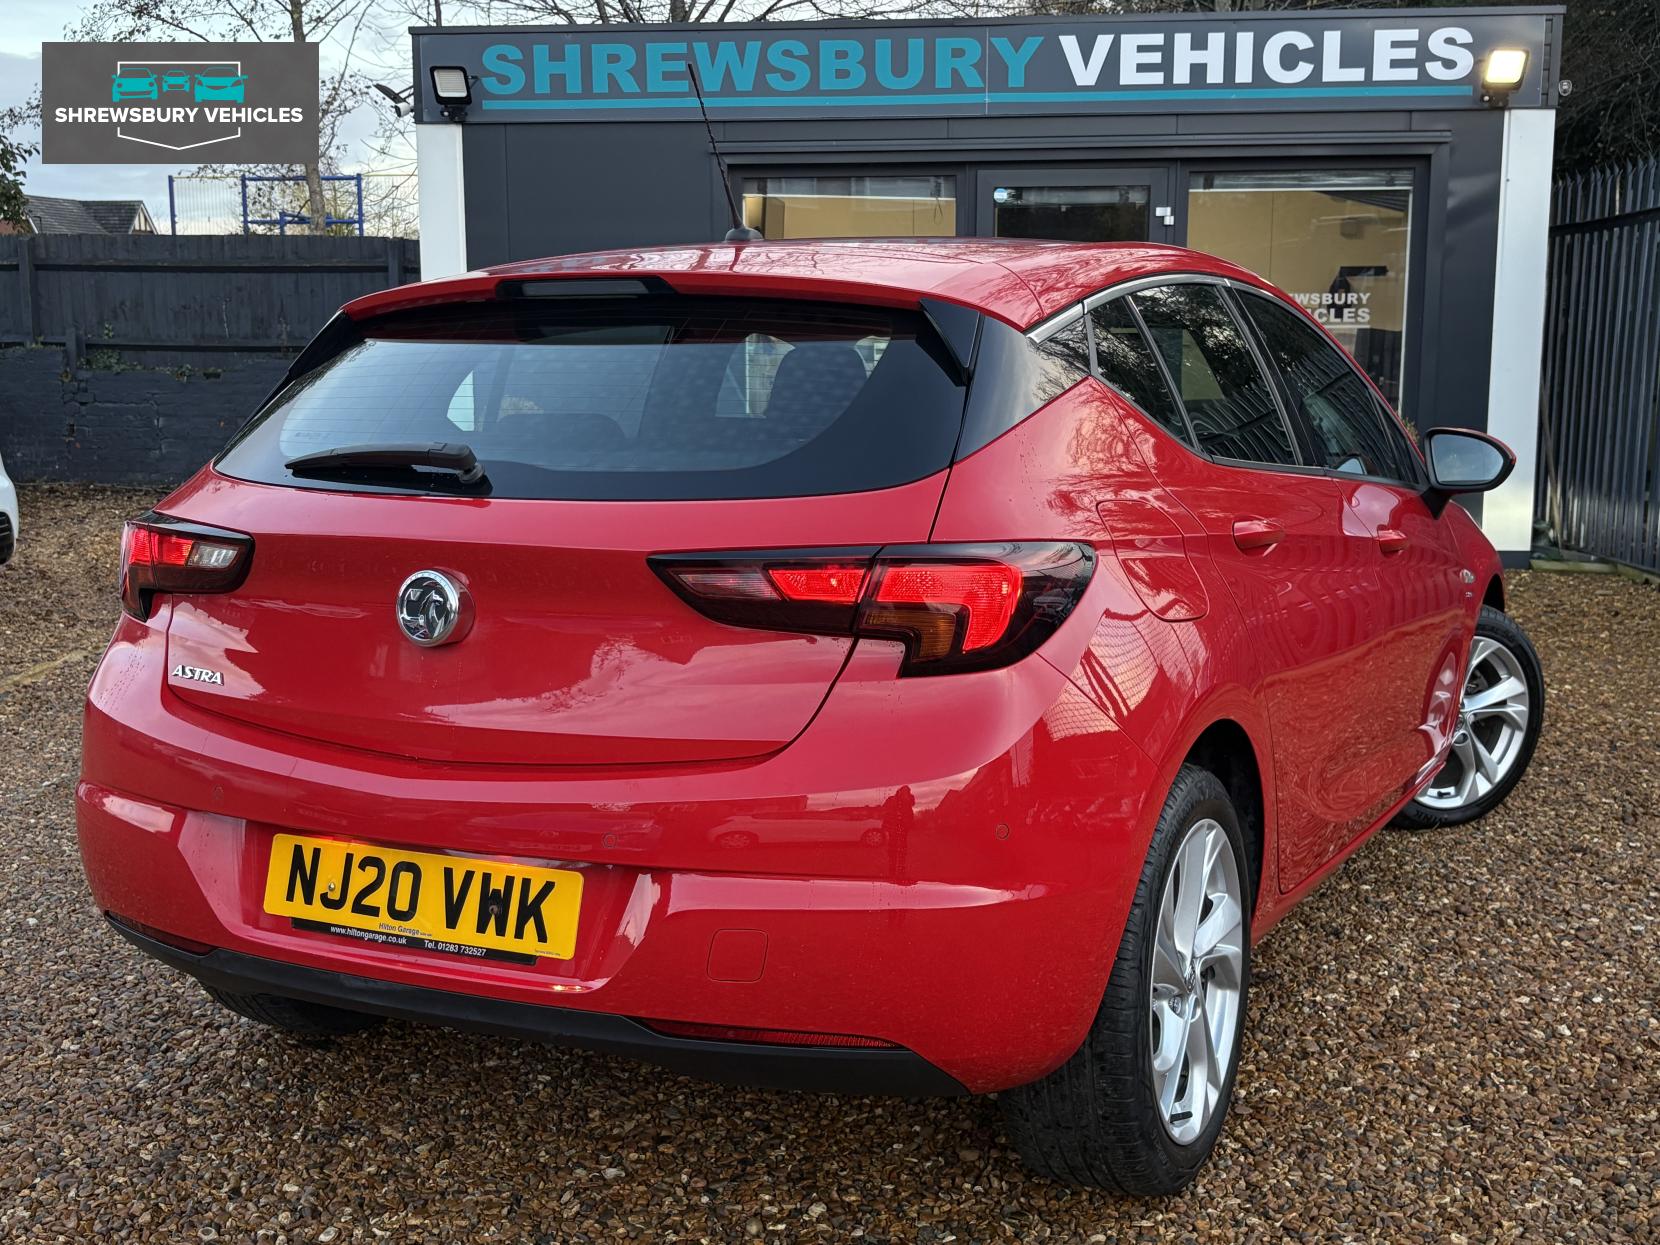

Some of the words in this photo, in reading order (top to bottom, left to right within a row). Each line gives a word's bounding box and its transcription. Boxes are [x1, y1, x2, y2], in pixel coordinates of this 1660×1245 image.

[482, 36, 1043, 95] SHREWSBURY
[1058, 27, 1474, 87] VEHICLES
[172, 664, 224, 686] ASTRA
[286, 844, 422, 922] NJ20
[443, 867, 556, 944] VWK
[330, 926, 407, 945] www.hiltongarage.co.uk
[424, 940, 436, 950] Tel.
[437, 942, 459, 953] 01283
[459, 945, 487, 957] 732527
[397, 925, 420, 936] Garage
